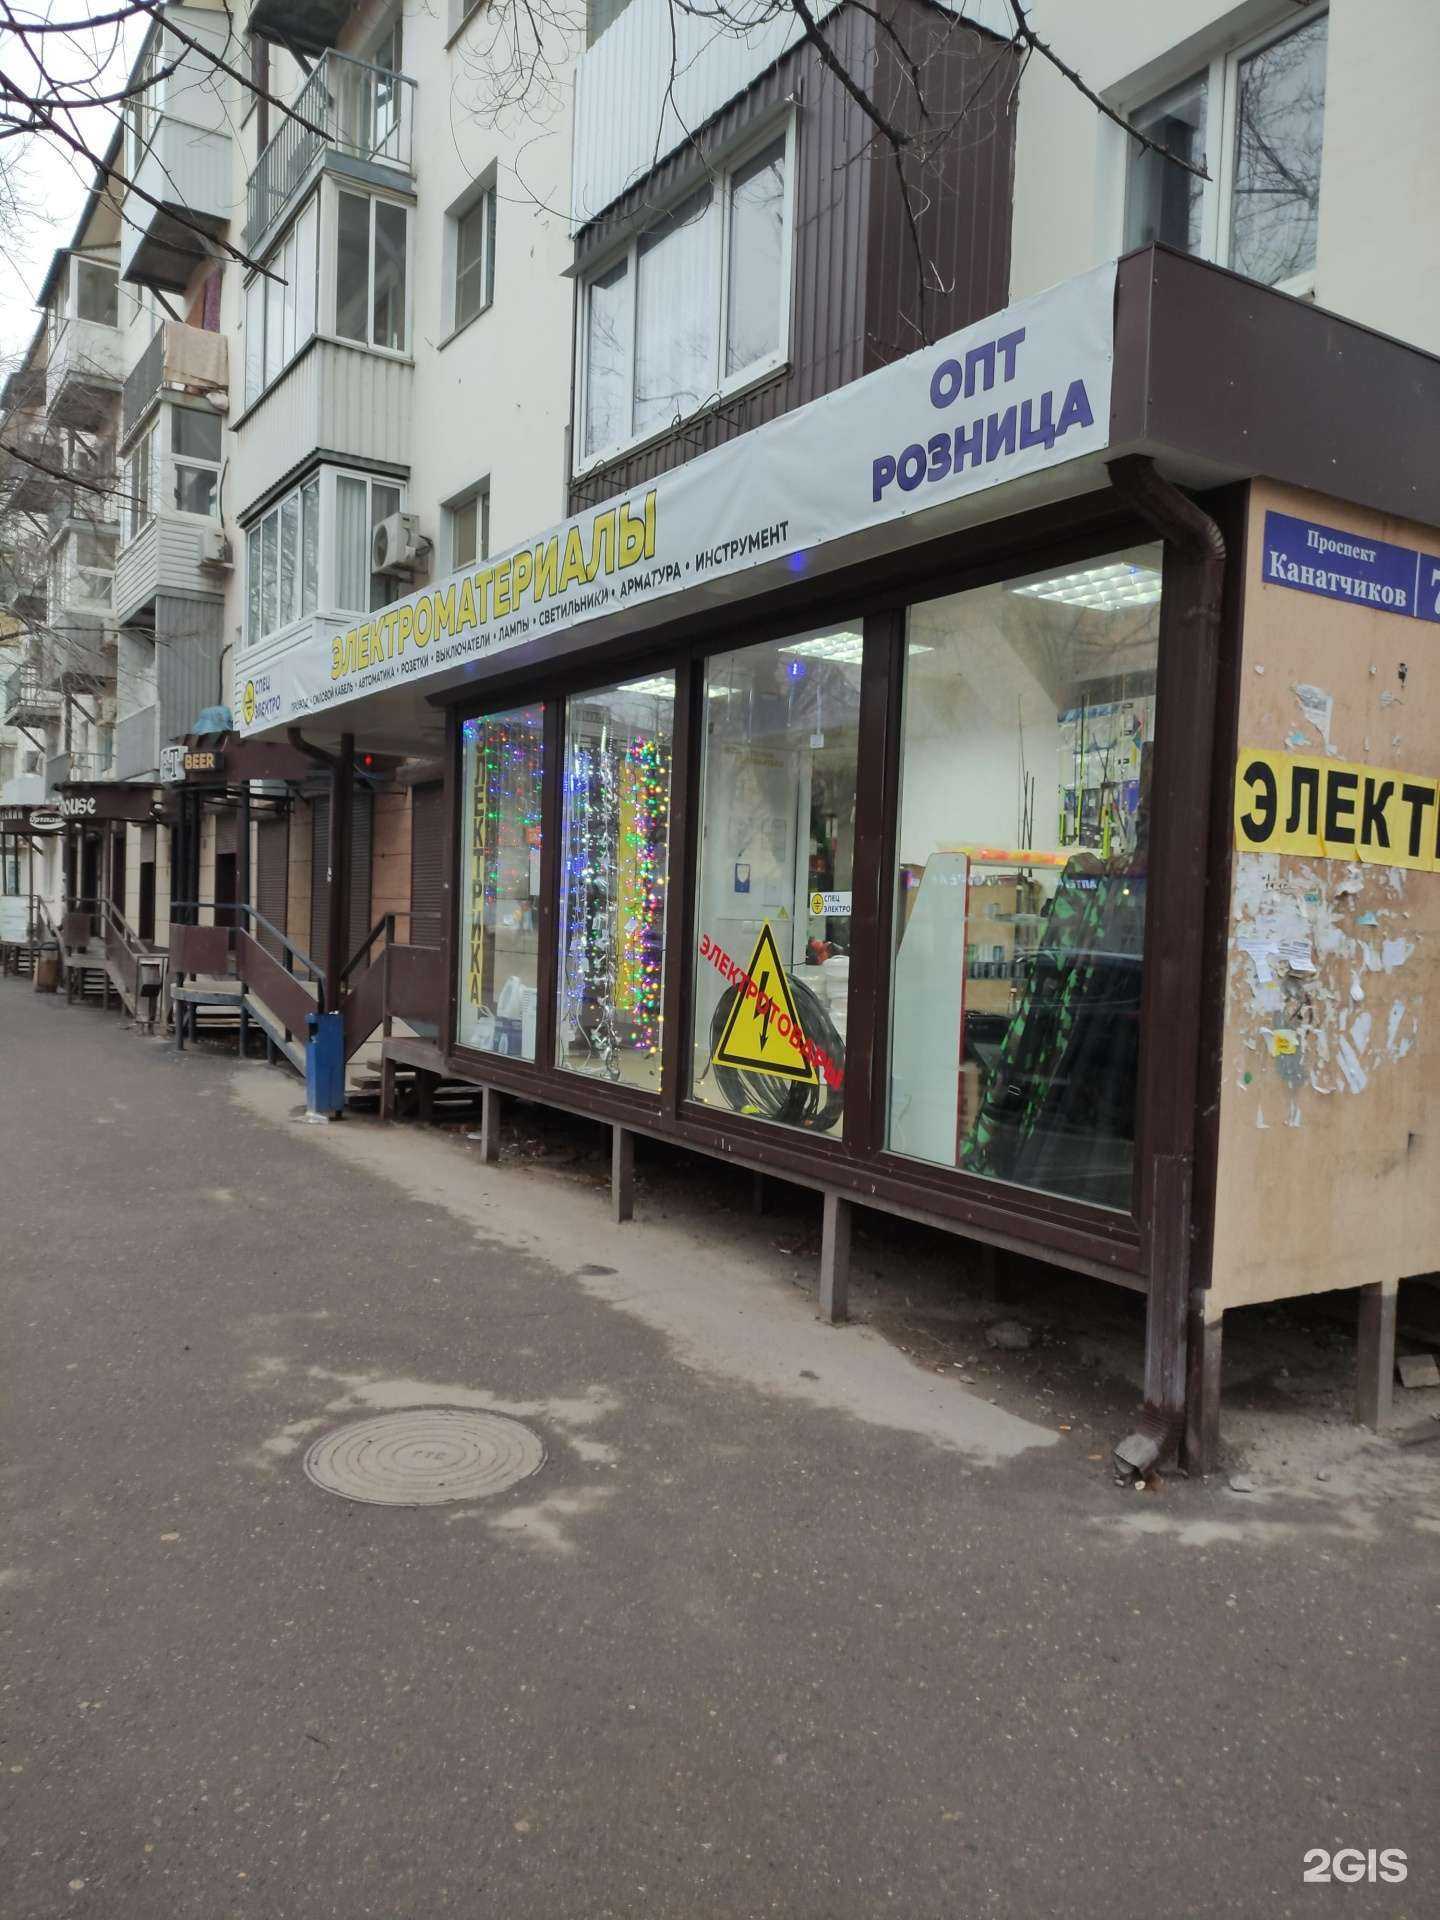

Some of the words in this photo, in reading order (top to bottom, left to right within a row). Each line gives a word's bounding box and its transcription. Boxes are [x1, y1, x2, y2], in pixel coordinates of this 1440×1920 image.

[930, 327, 1026, 410] ОПТ
[872, 379, 1095, 502] РОЗНИЦА
[1269, 550, 1407, 608] Канатчиков
[1307, 529, 1377, 563] Проспект
[330, 489, 657, 680] ЭЛЕКТРОМАТЕРИАЛЫ
[334, 682, 354, 697] КАБЕЛЬ
[358, 667, 395, 689] АВТОМАТИКА
[401, 655, 430, 674] РОЗЕТКИ
[435, 633, 491, 663] ВЫКЛЮЧАТЕЛИ
[499, 618, 530, 642] ЛАМПЫ
[539, 588, 609, 627] СВЕТИЛЬНИКИ
[619, 562, 682, 599] АРМАТУРА
[695, 520, 789, 572] ИНСТРУМЕНТ
[255, 675, 272, 696] СПЕЦ
[184, 752, 215, 770] BEER
[1240, 760, 1440, 858] ЭЛЕКТ
[823, 895, 840, 903] СПЕЦ
[823, 905, 851, 913] ЭЛЕКТРО
[699, 933, 846, 1090] ЭЛЕКТРОТОВАРЫ
